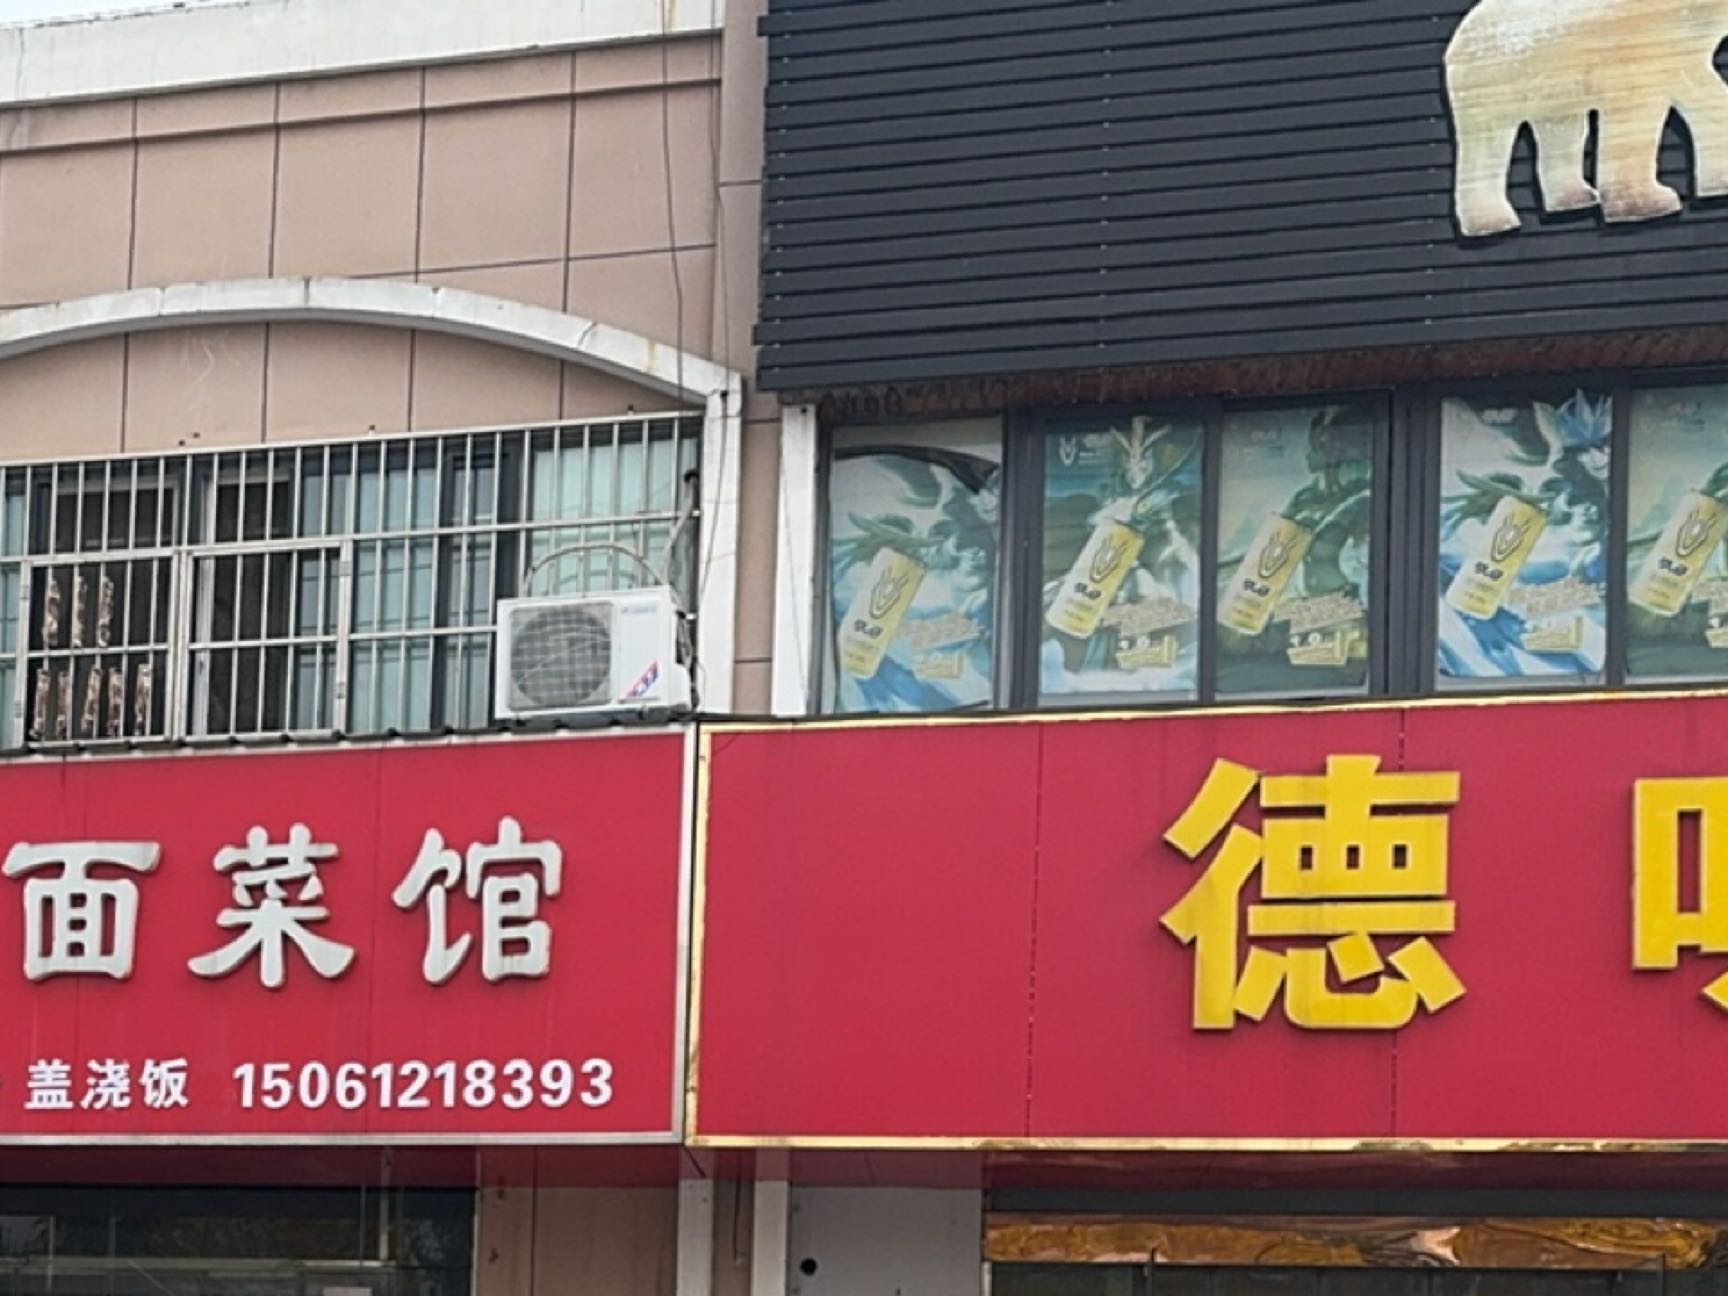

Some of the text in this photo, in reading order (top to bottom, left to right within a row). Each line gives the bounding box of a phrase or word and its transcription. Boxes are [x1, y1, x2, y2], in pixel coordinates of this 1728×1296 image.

[1159, 754, 1728, 1032] 德
[24, 1058, 190, 1110] 盖浇饭
[232, 1057, 615, 1109] 15061218393
